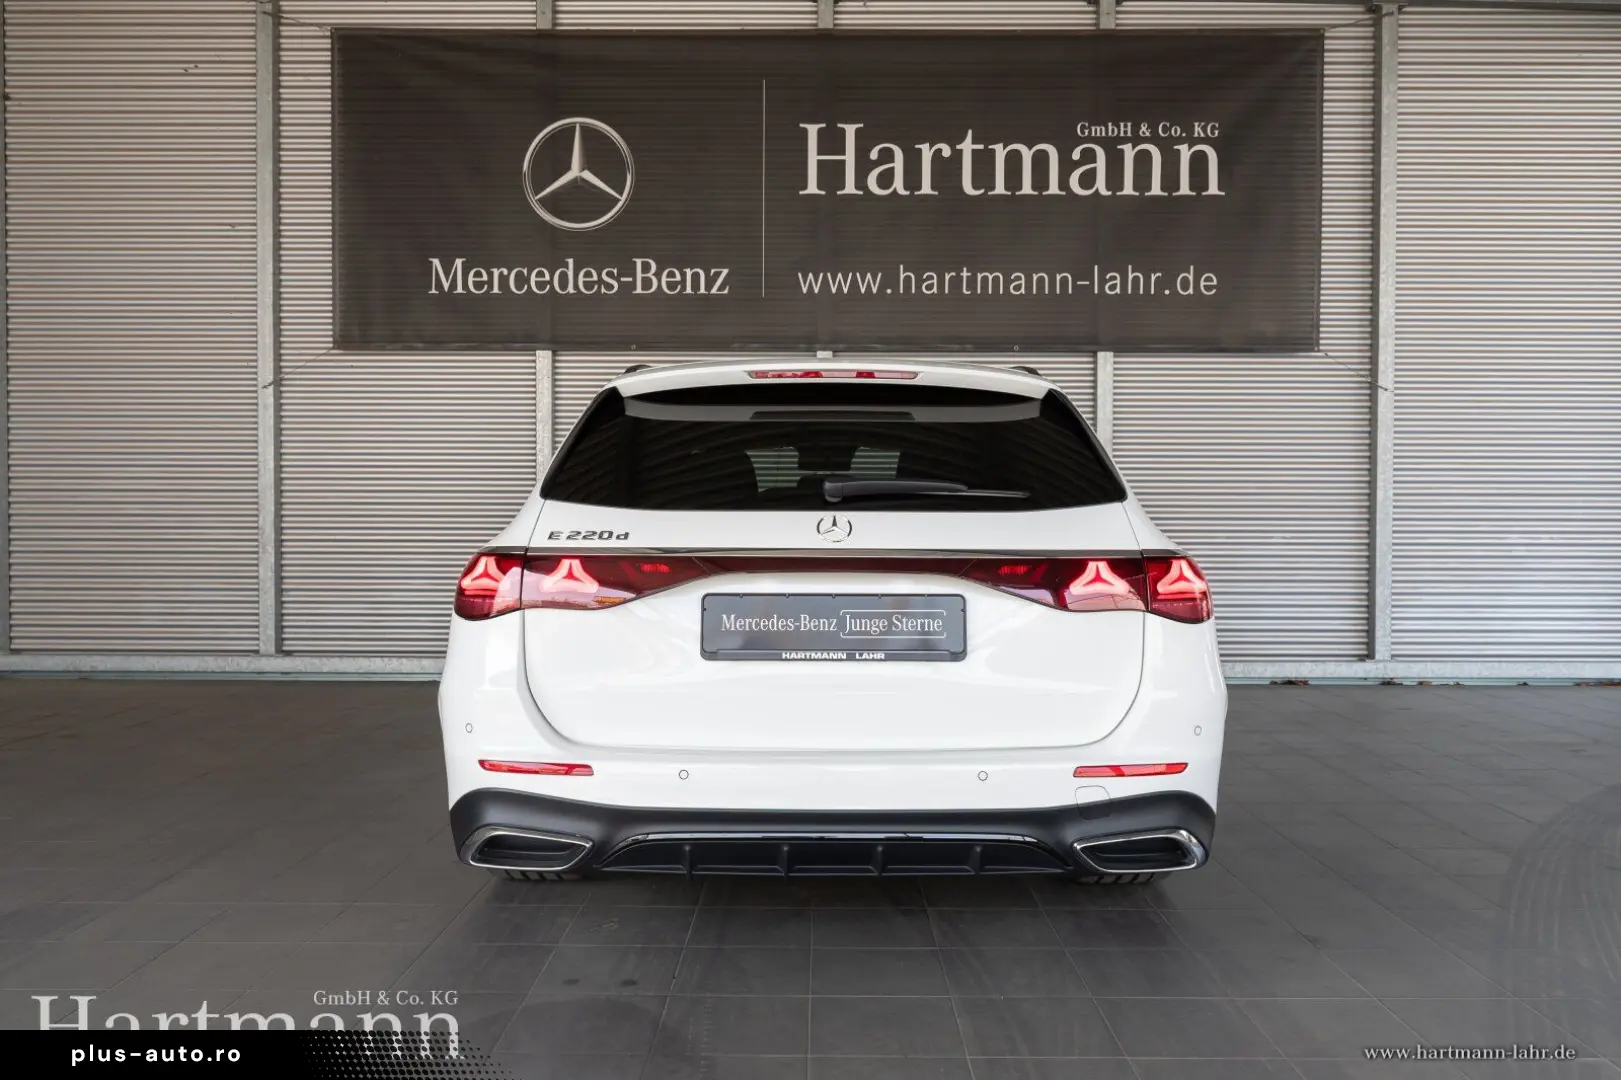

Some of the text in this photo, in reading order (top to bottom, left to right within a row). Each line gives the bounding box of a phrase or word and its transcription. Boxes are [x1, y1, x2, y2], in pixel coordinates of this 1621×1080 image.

[1076, 121, 1220, 138] GmbH & Co. KG
[798, 122, 1226, 197] Hartmann
[427, 257, 731, 297] Mercedes-Benz
[797, 263, 1219, 297] www.hartmann-lahr.de
[547, 530, 564, 541] E
[720, 613, 943, 635] Mercedes-Benz Junge Sterne
[781, 652, 886, 661] HARTMANN LAHR
